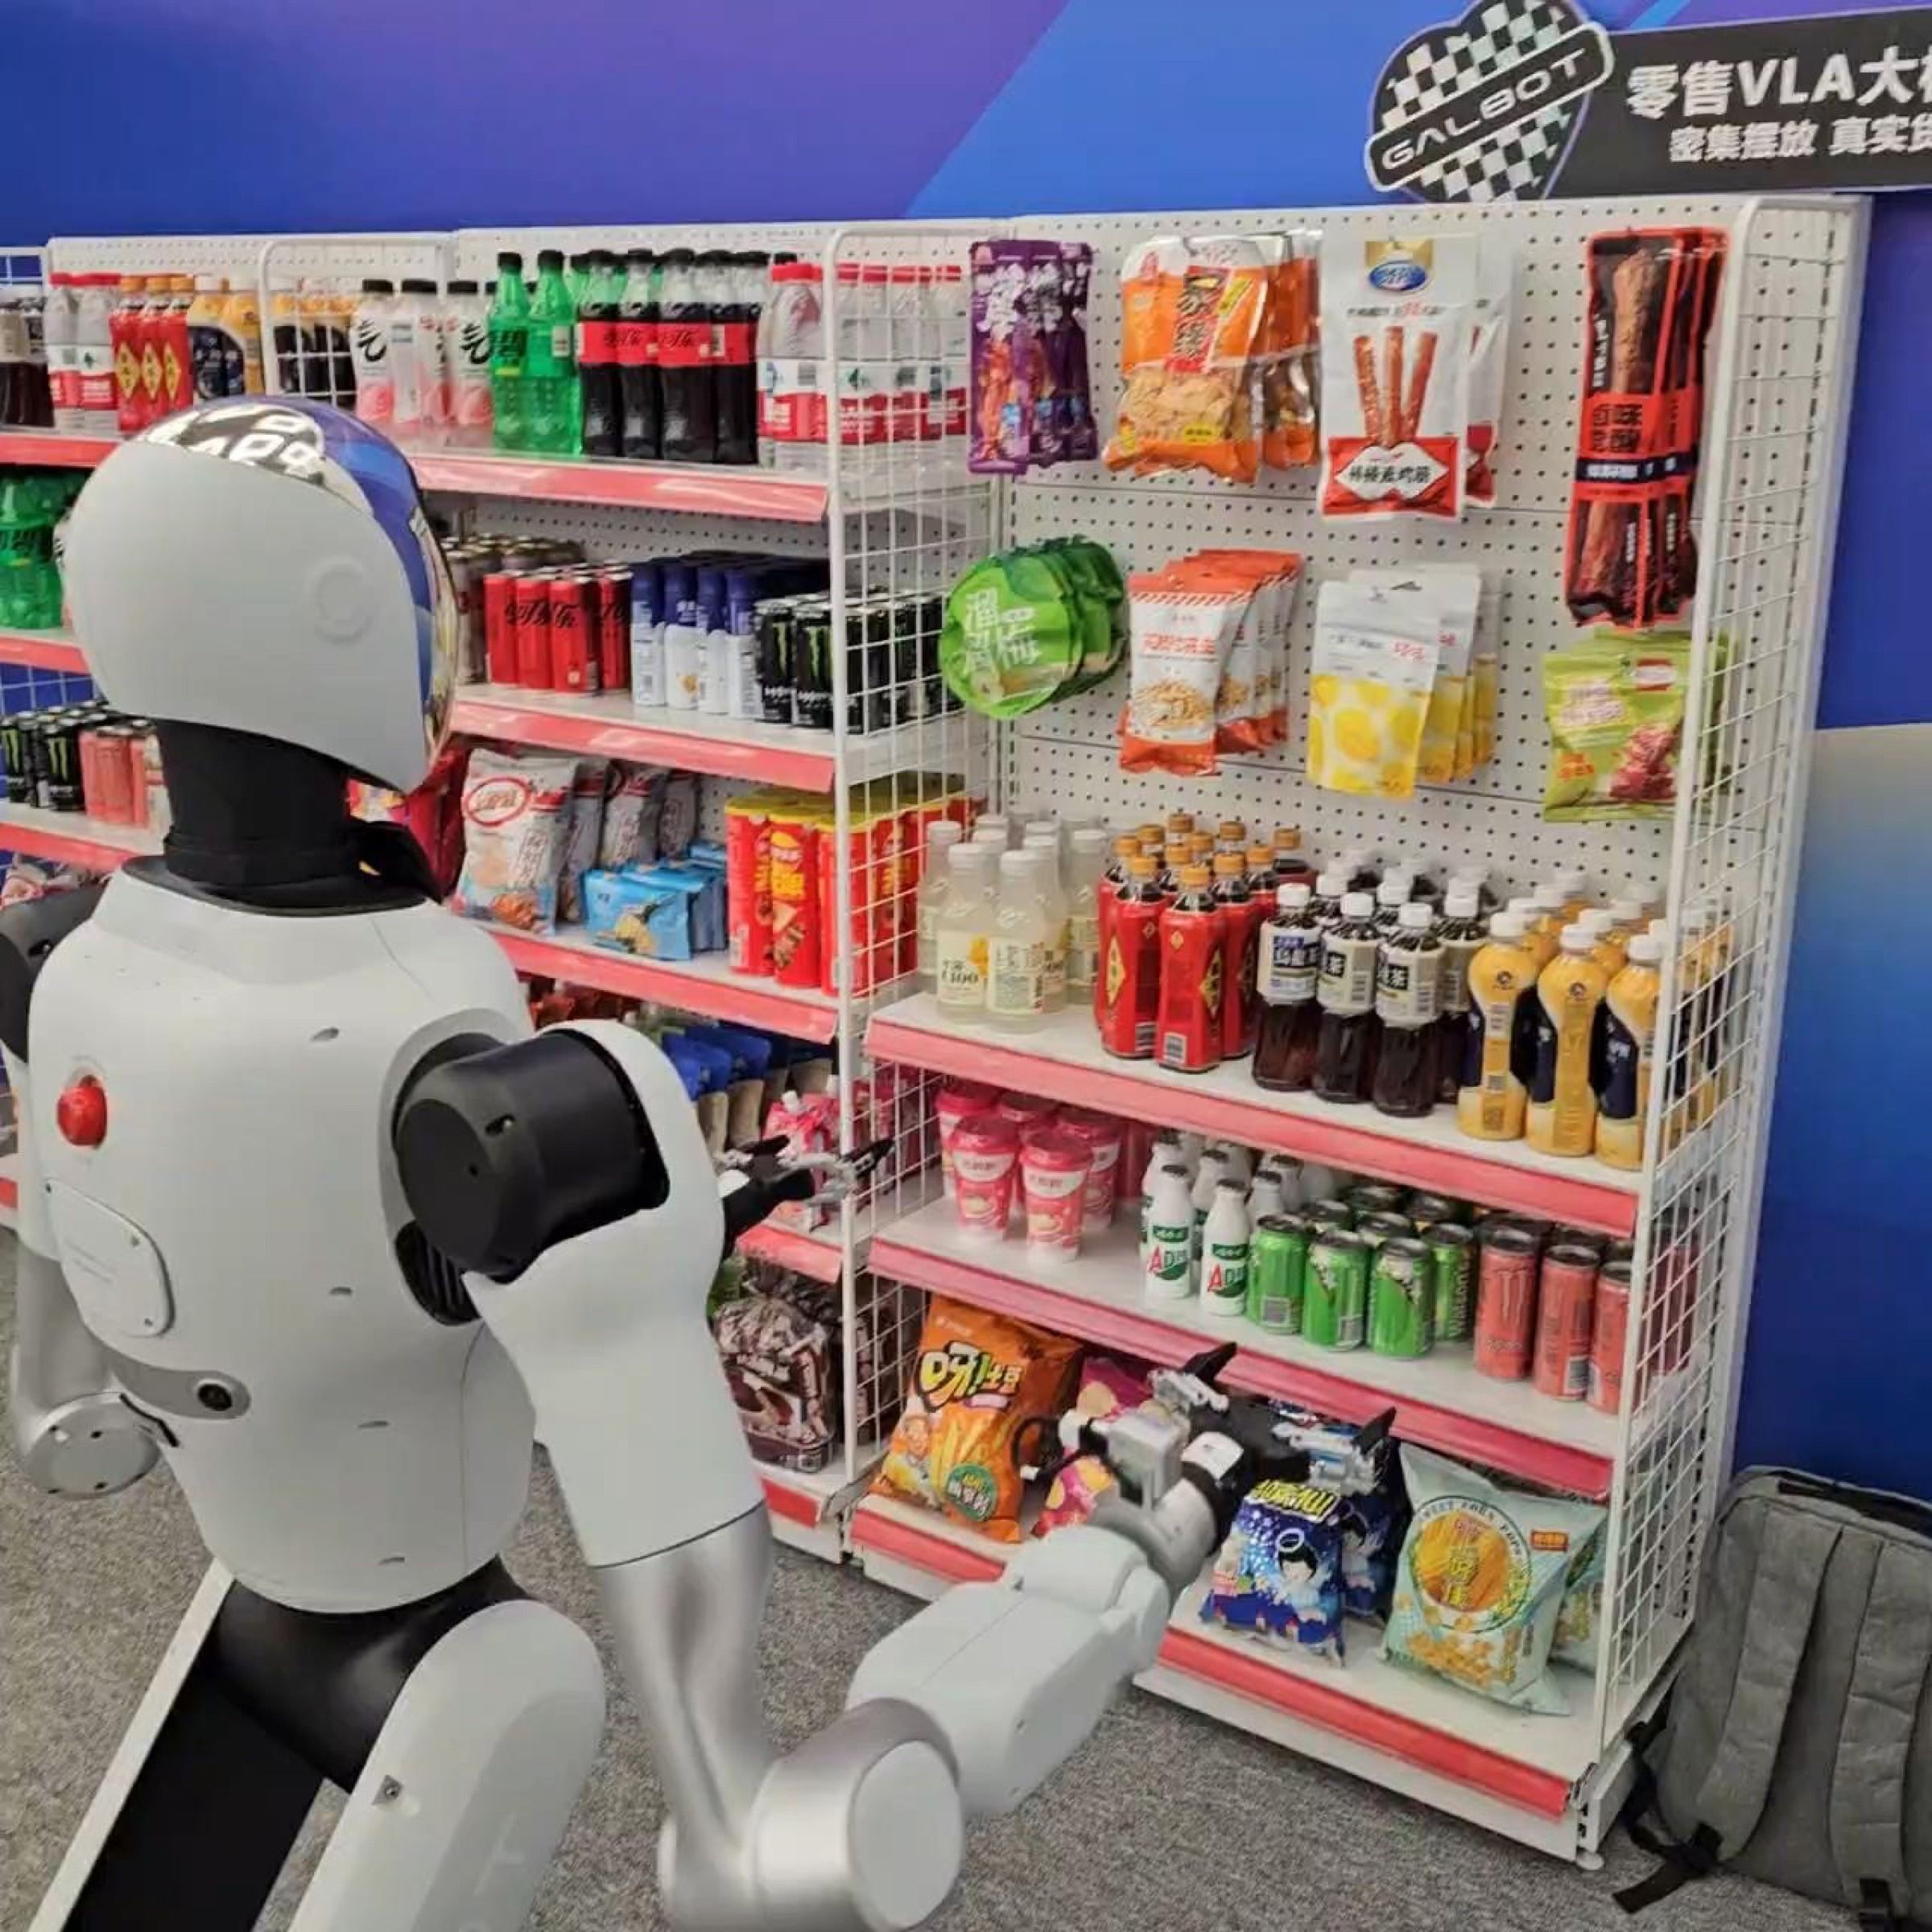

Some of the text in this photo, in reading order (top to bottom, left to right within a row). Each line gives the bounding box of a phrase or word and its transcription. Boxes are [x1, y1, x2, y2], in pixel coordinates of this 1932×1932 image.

[1381, 47, 1586, 170] GALBOT
[1626, 44, 1932, 120] 零售VLA大
[1669, 119, 1819, 163] 密集摆放
